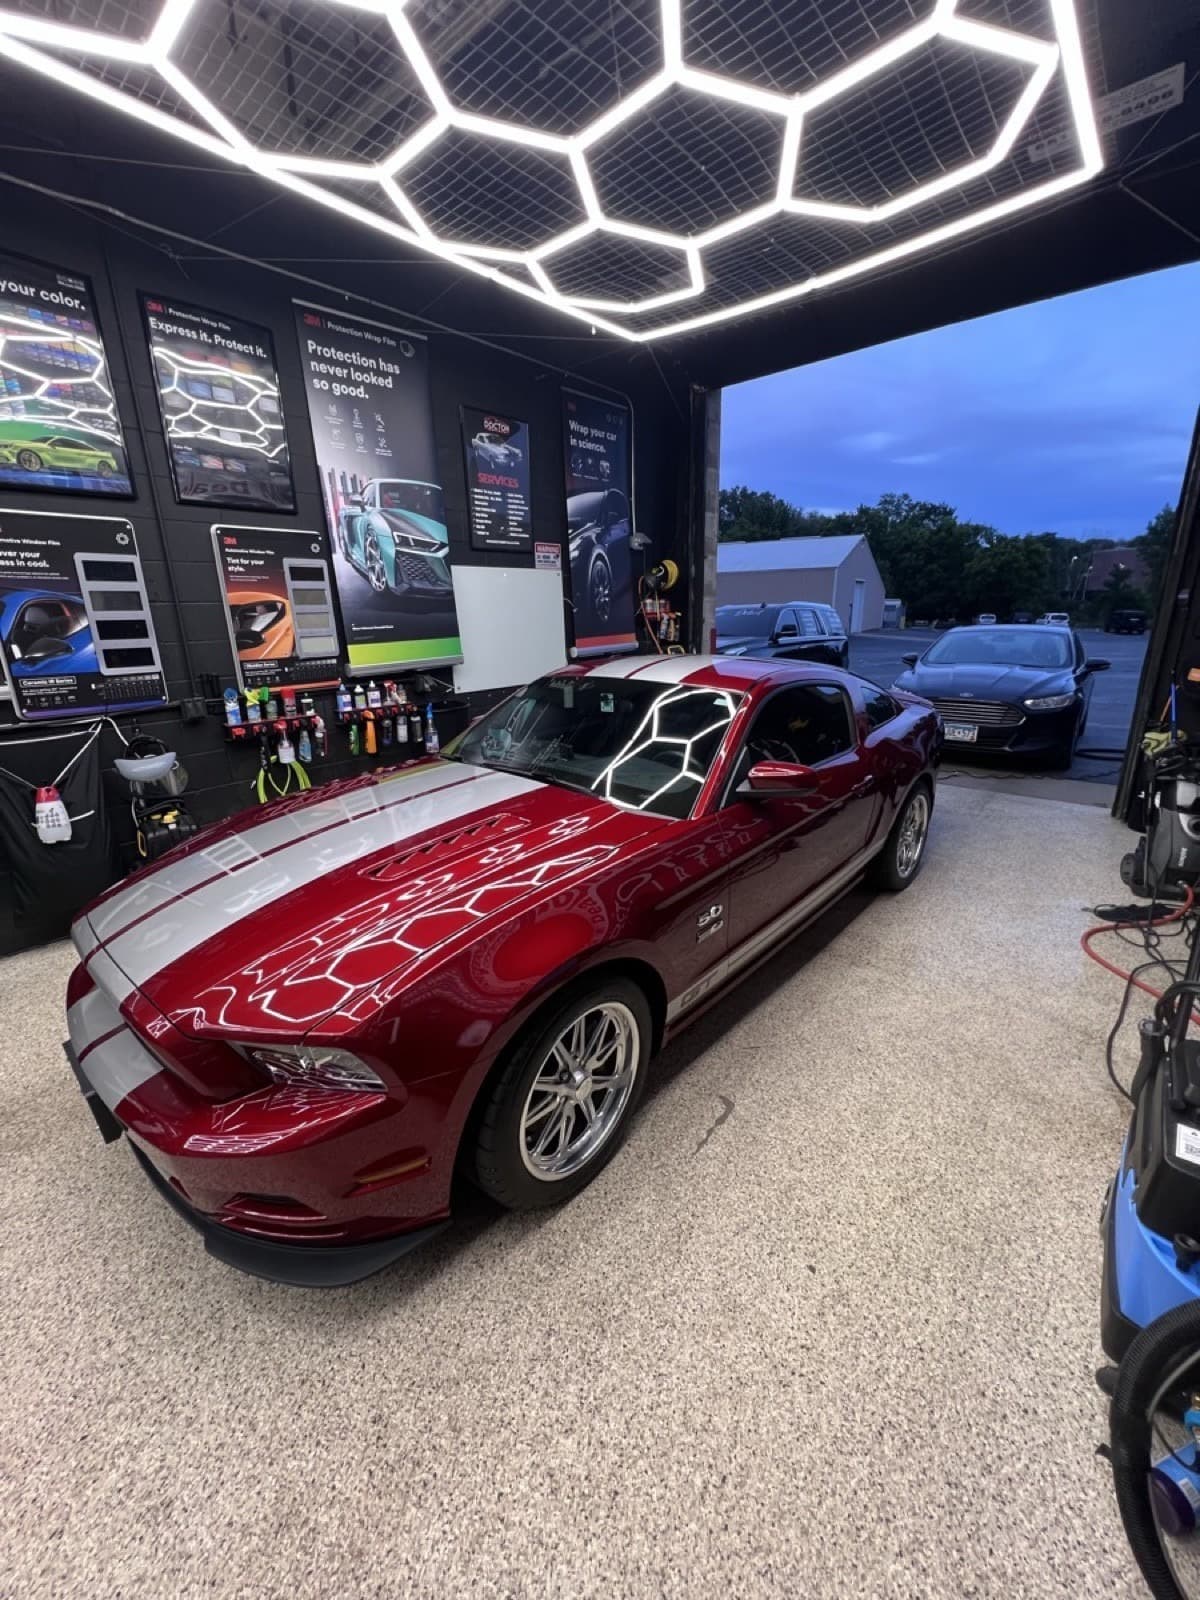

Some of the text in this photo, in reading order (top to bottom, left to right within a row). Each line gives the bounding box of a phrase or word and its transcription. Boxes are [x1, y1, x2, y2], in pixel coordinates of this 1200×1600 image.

[0, 280, 36, 297] your
[40, 290, 86, 311] color.
[168, 307, 201, 322] Protection
[201, 316, 218, 329] Wrap
[218, 321, 232, 332] Film
[149, 316, 268, 358] Express it. Protect it.
[327, 321, 364, 338] Protection
[363, 331, 382, 344] Wrap
[382, 336, 397, 347] Film
[307, 339, 401, 375] Protection has
[310, 361, 393, 389] never looked
[312, 378, 369, 399] so good.
[568, 419, 617, 441] Wrap your car
[570, 434, 578, 446] in
[477, 472, 519, 489] SERVICES
[223, 536, 238, 545] 3M
[19, 551, 40, 560] your
[27, 560, 50, 568] cool.
